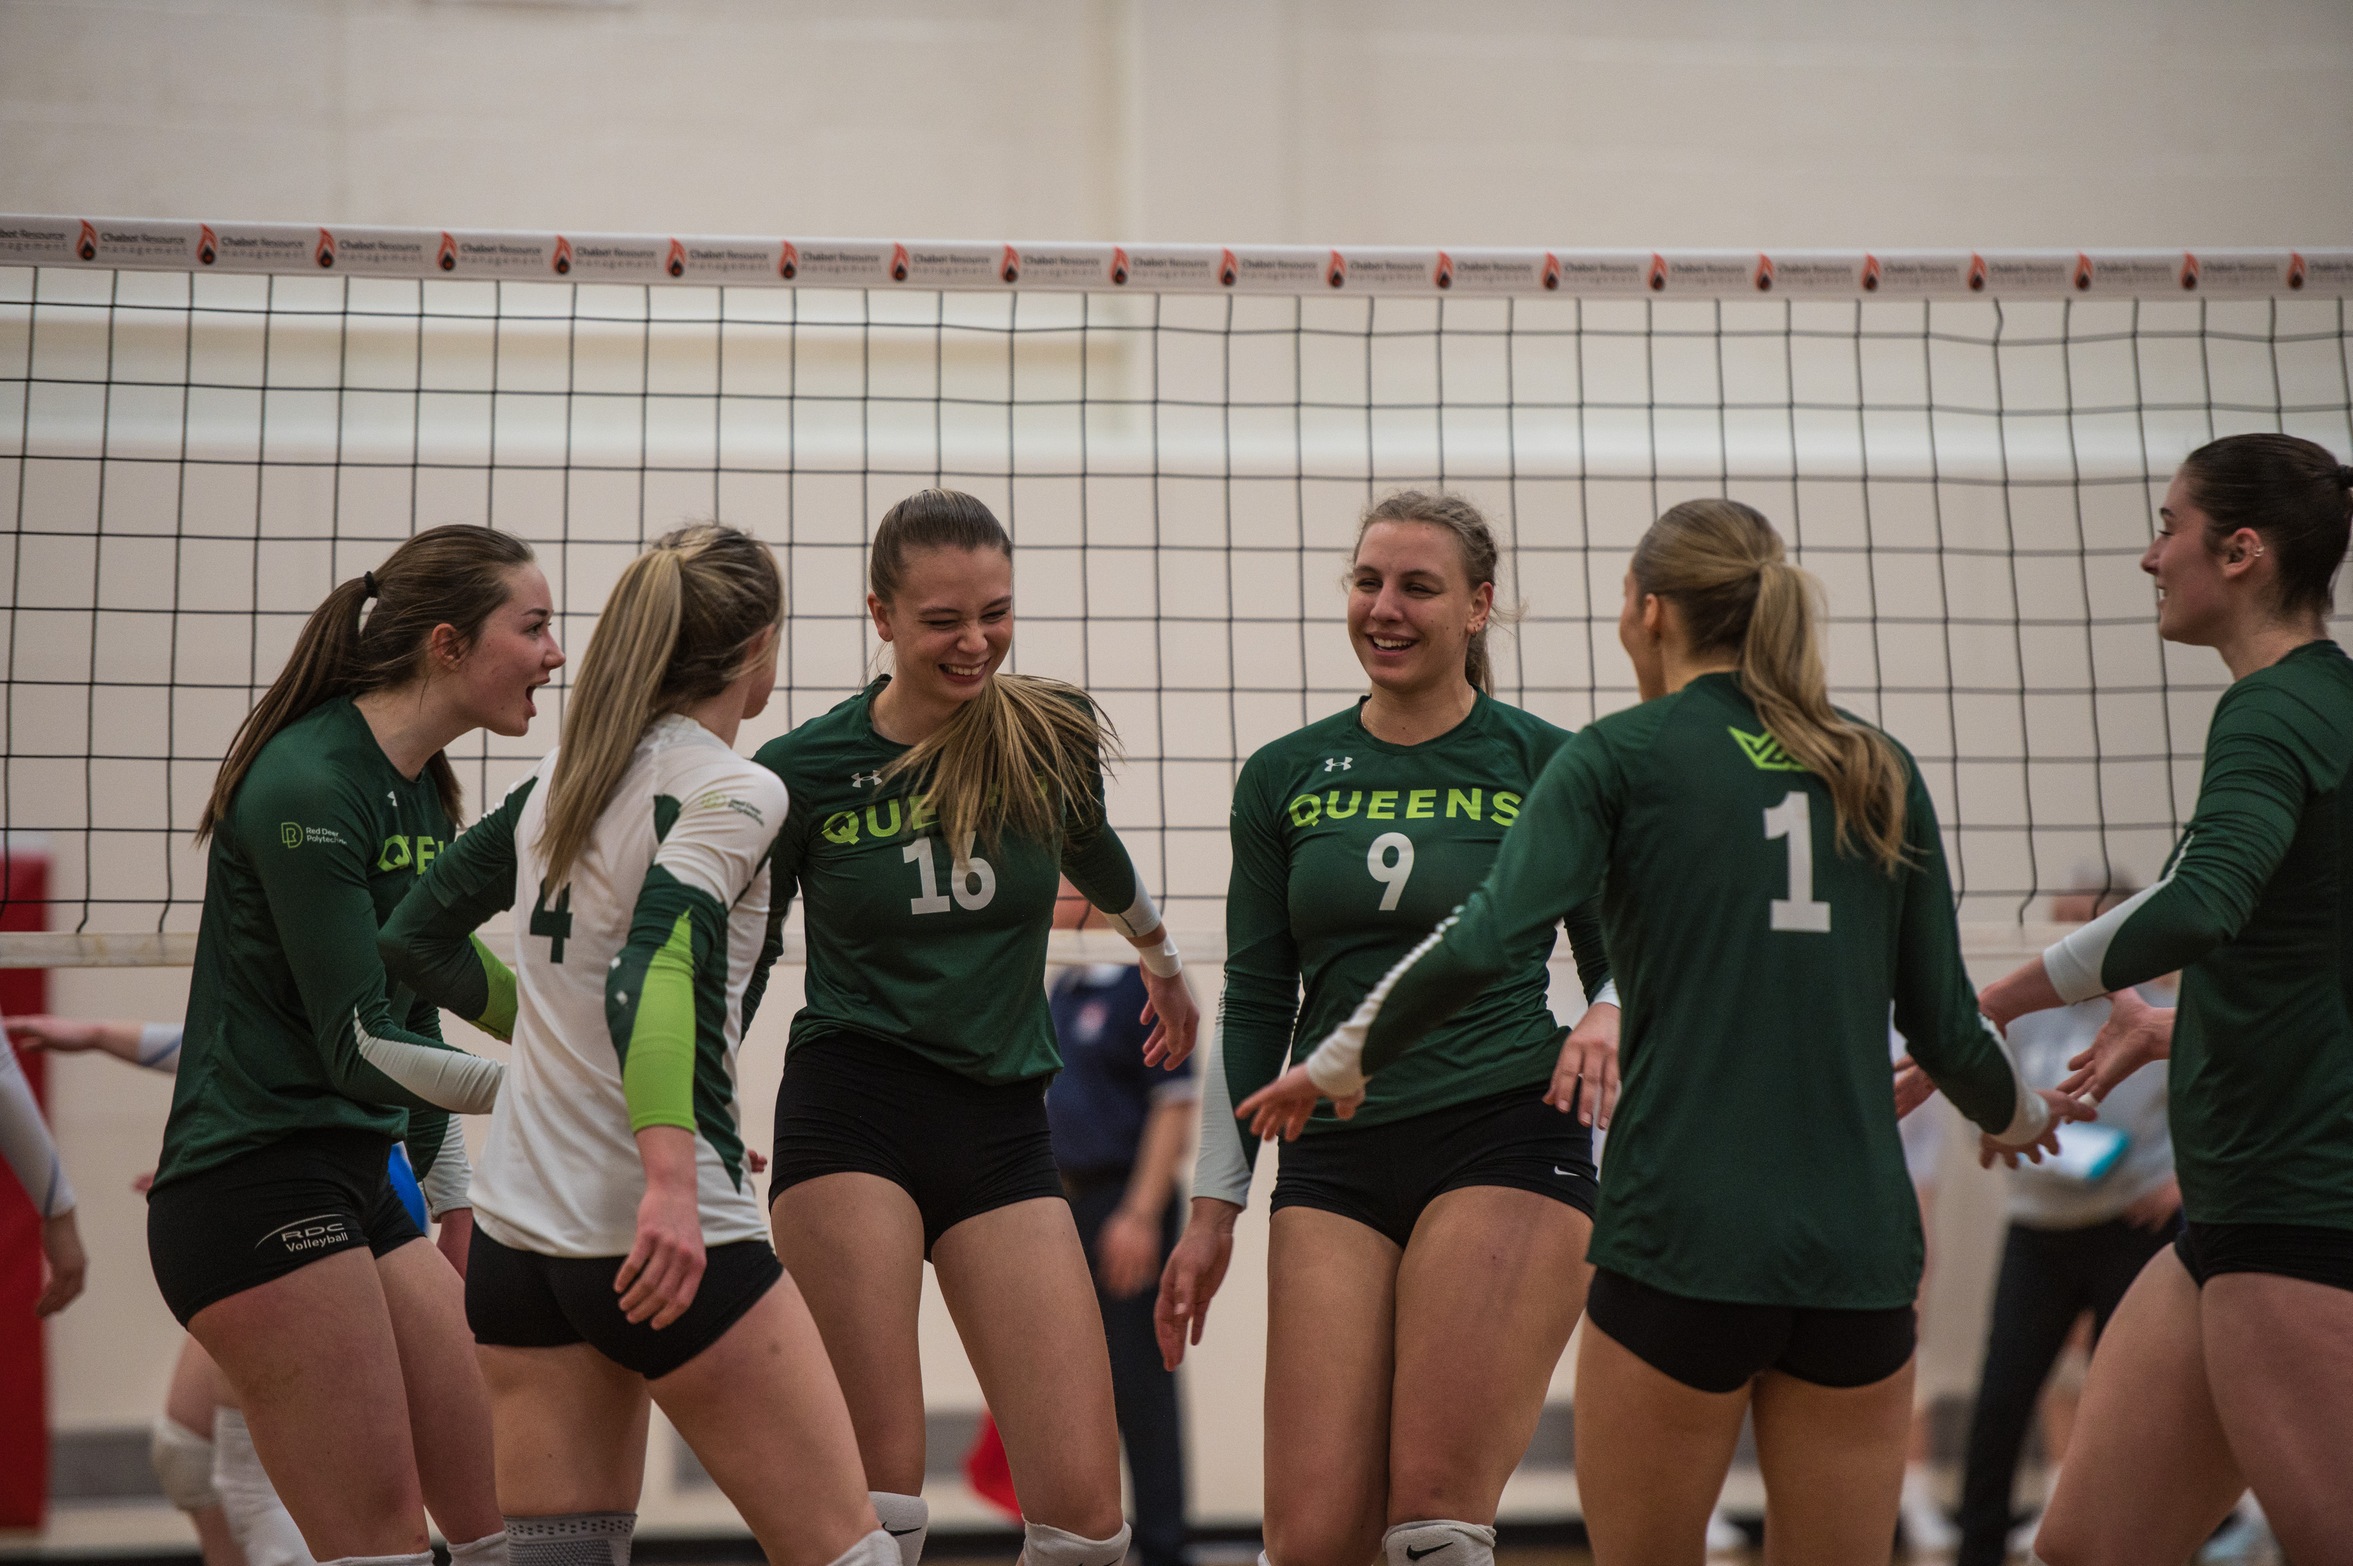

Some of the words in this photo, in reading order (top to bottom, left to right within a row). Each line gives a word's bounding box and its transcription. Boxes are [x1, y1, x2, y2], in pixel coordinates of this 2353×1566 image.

[305, 827, 320, 835] Red
[321, 828, 339, 837] Deer
[1289, 788, 1522, 827] QUEENS
[902, 831, 996, 915] 16
[1367, 832, 1414, 911] 9
[1763, 791, 1831, 933] 1
[529, 878, 573, 964] 4
[281, 1223, 345, 1242] RDC
[286, 1232, 349, 1252] Volleyball
